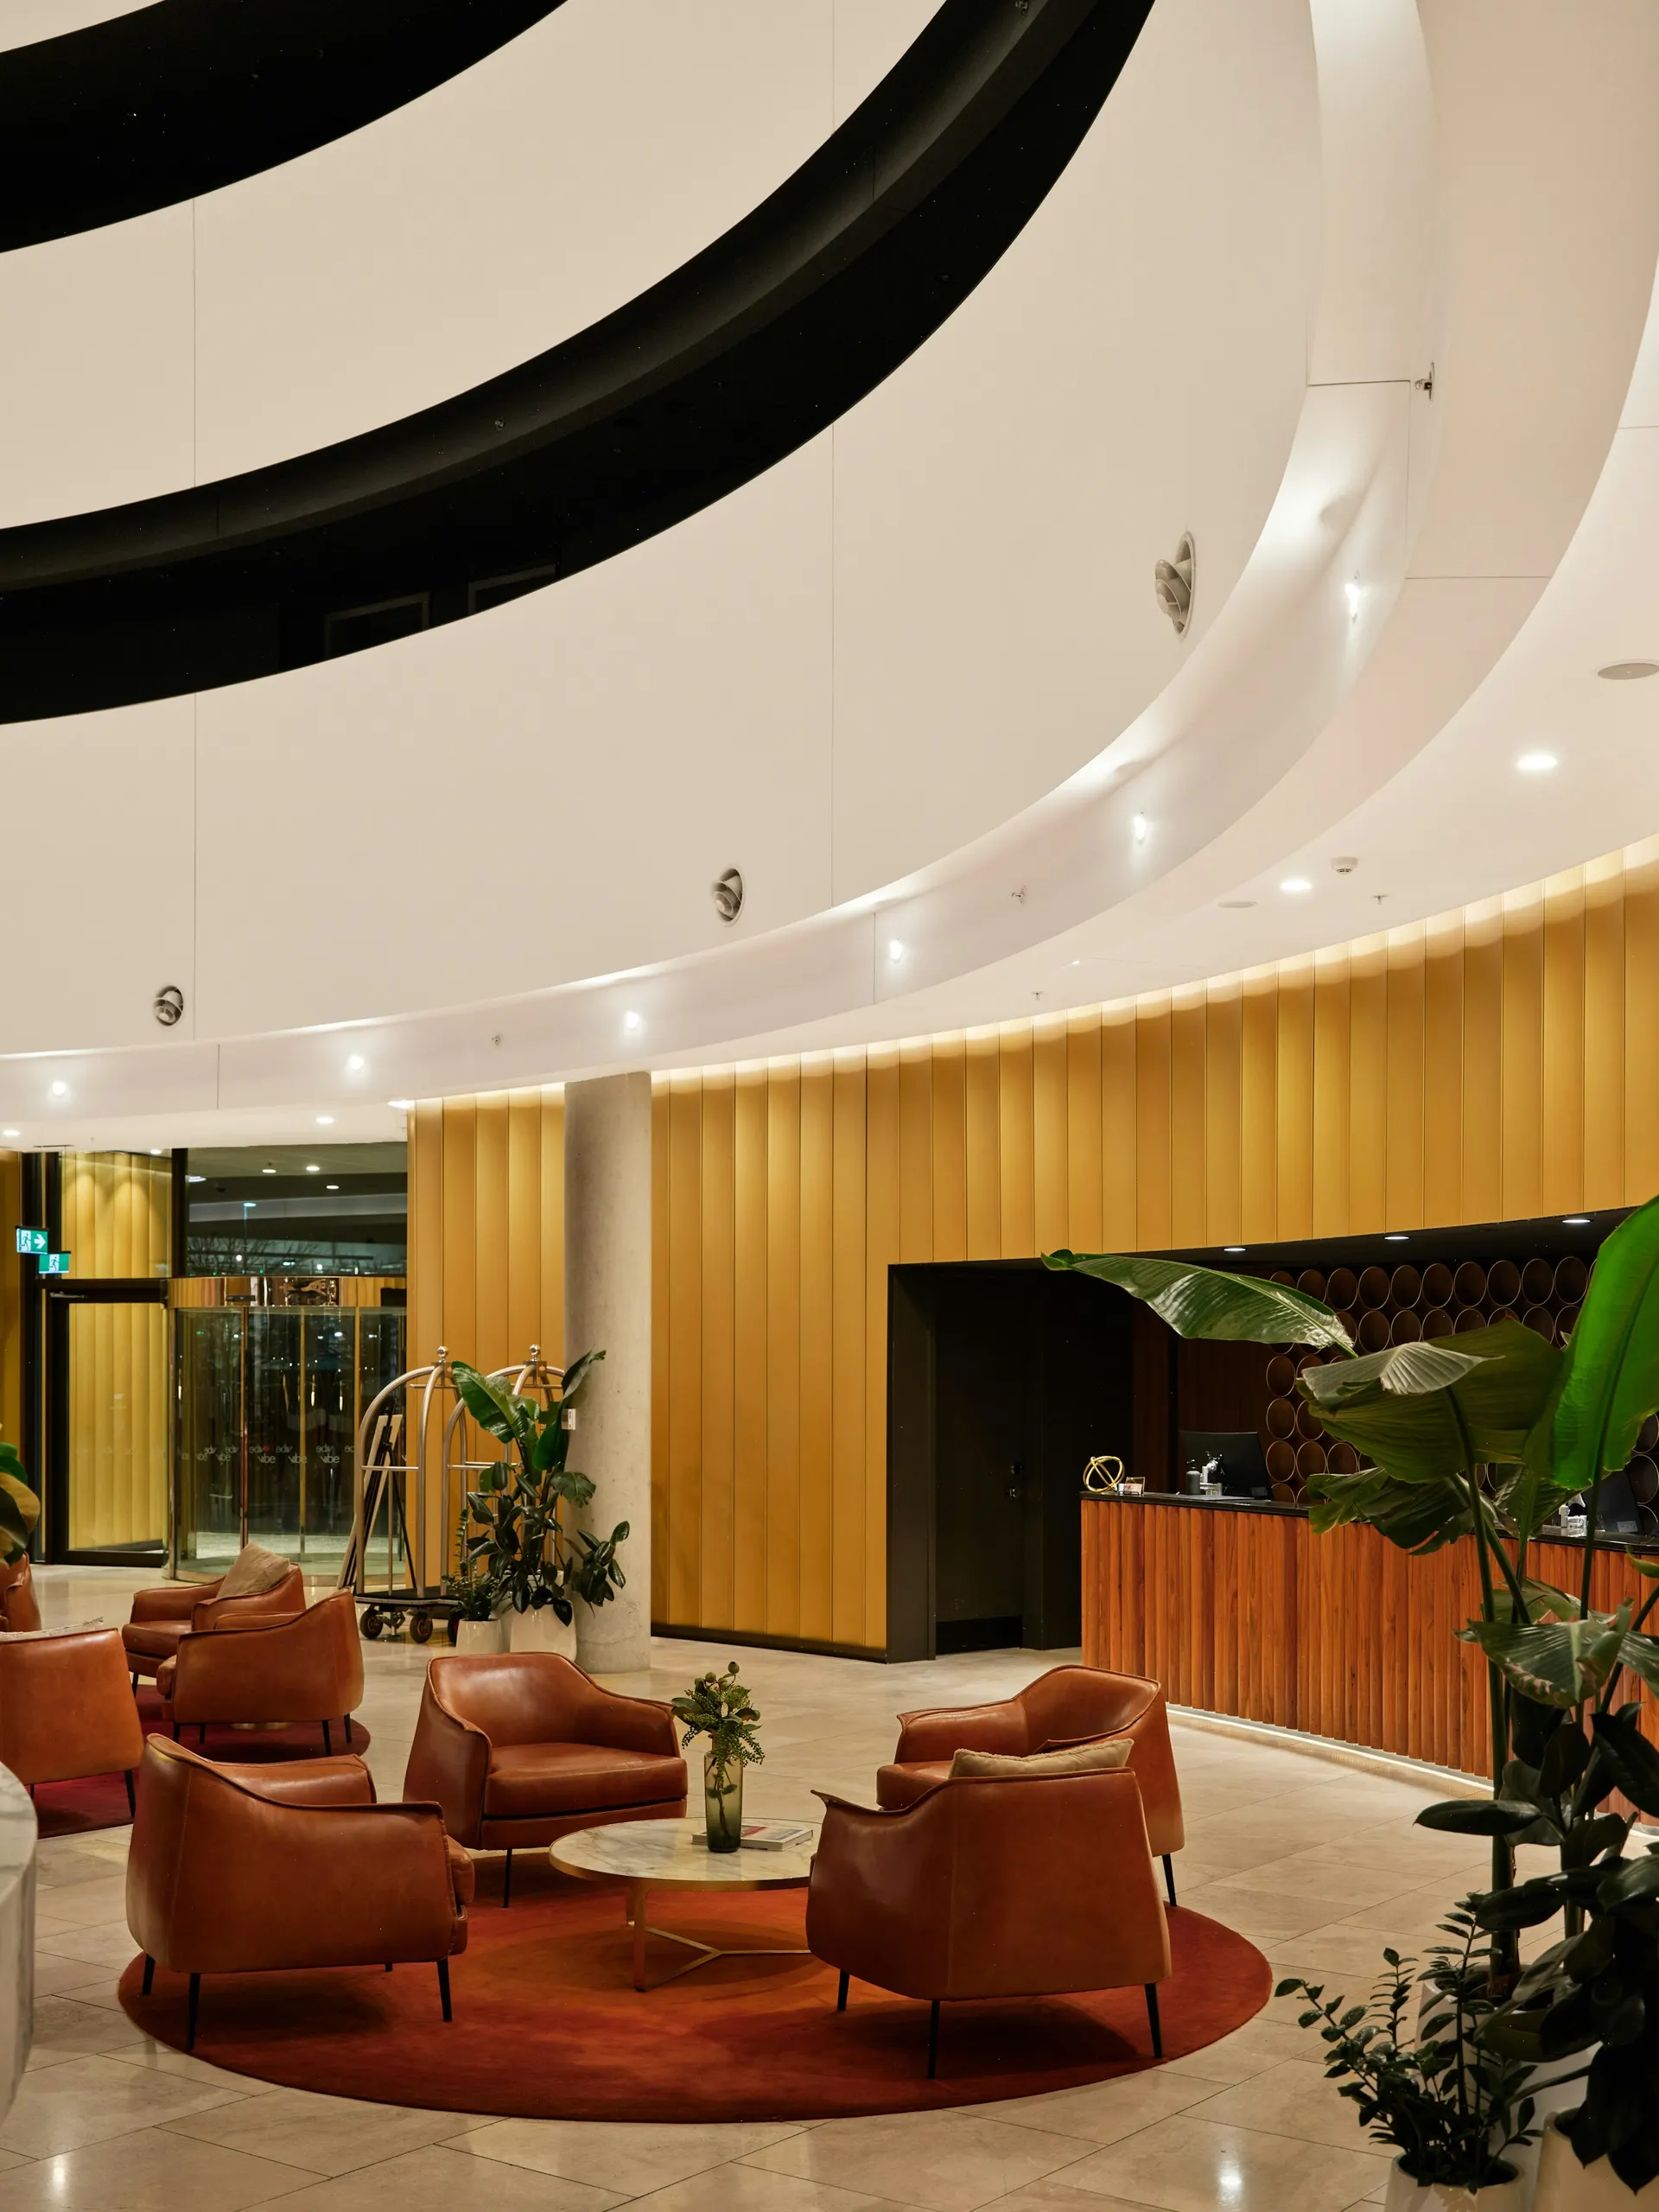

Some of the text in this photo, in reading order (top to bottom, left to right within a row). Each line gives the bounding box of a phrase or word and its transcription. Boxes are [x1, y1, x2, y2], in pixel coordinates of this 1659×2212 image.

[257, 1452, 276, 1464] vibe
[288, 1452, 308, 1464] vibe
[320, 1452, 340, 1464] vibe
